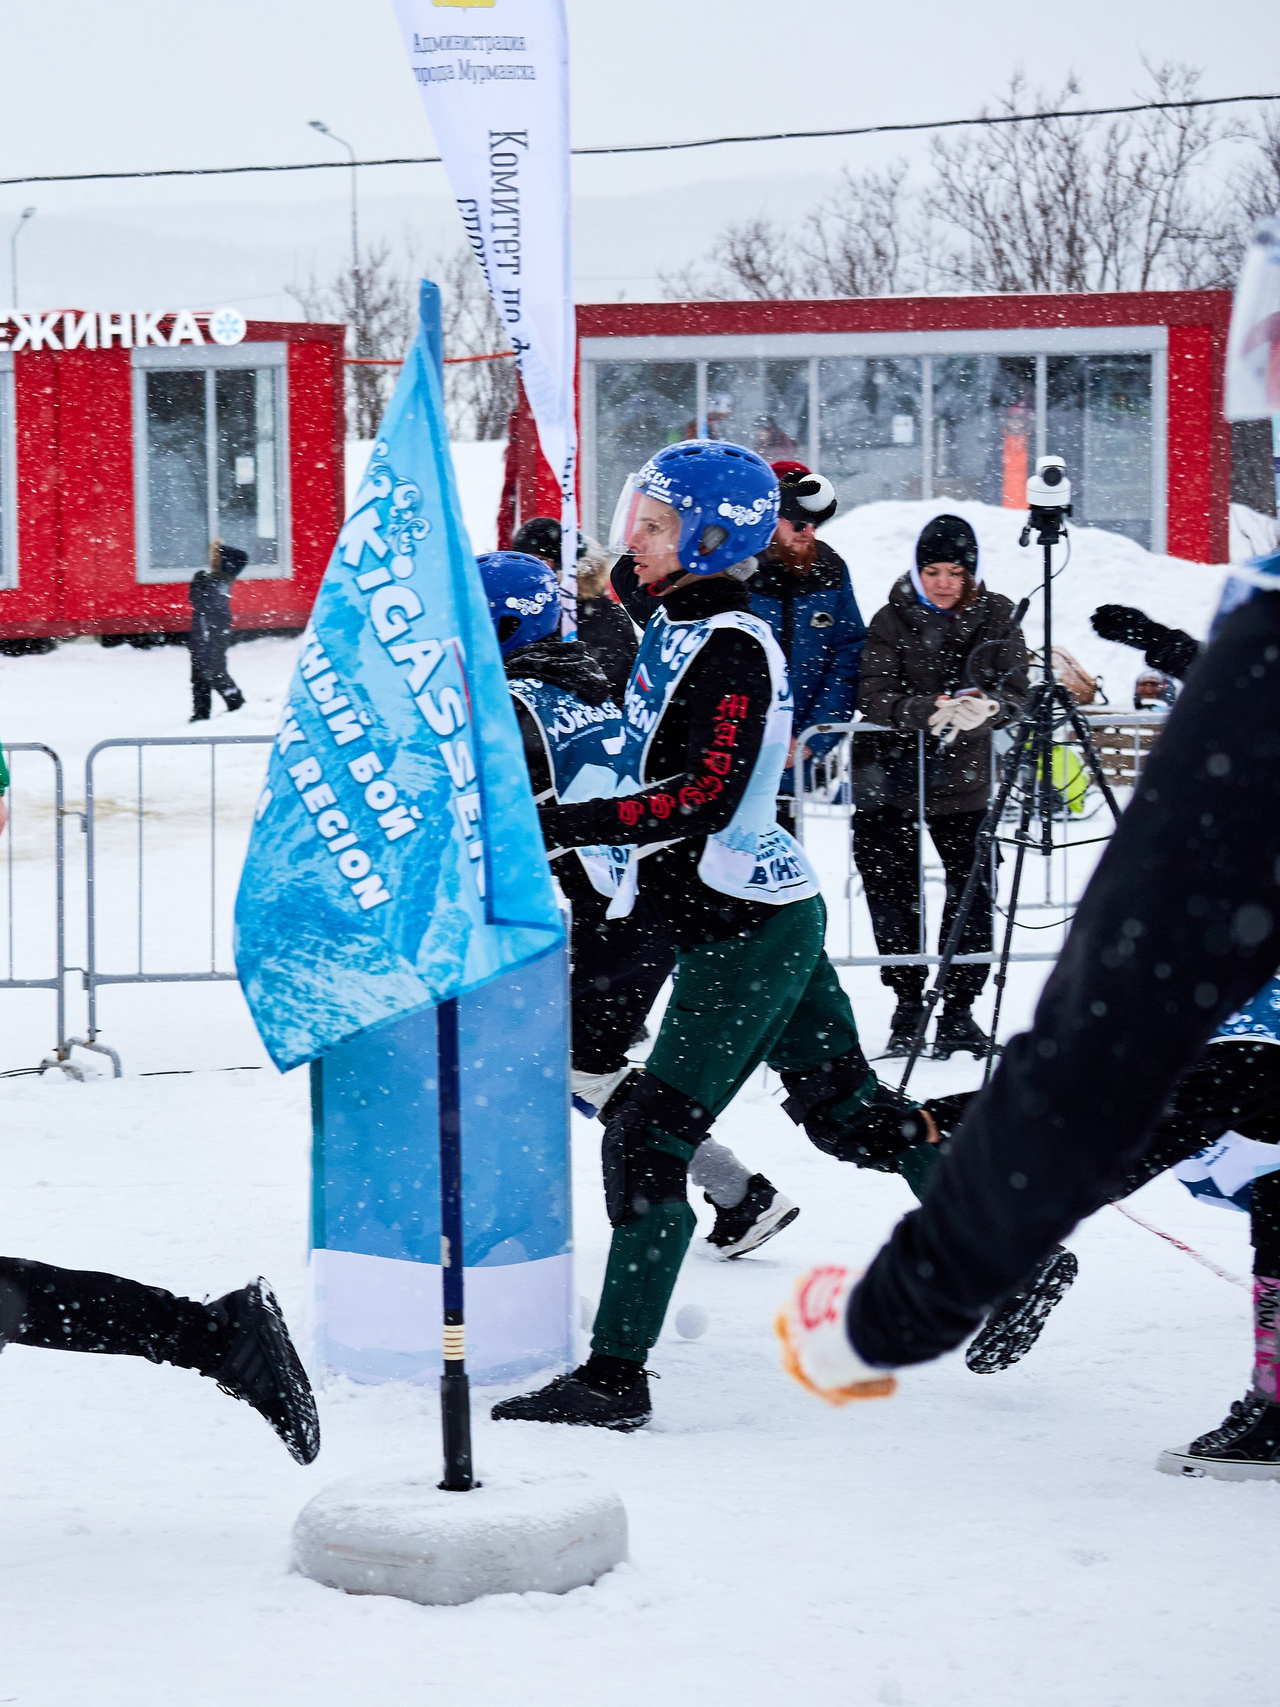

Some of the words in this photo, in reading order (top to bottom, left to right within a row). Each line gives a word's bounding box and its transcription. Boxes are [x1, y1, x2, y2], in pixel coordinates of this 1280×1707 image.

[489, 129, 529, 275] Комитет
[300, 624, 371, 747] НЫЙ
[348, 751, 424, 842] БОЙ
[546, 700, 623, 742] YUKIGASS
[287, 755, 392, 911] REGION
